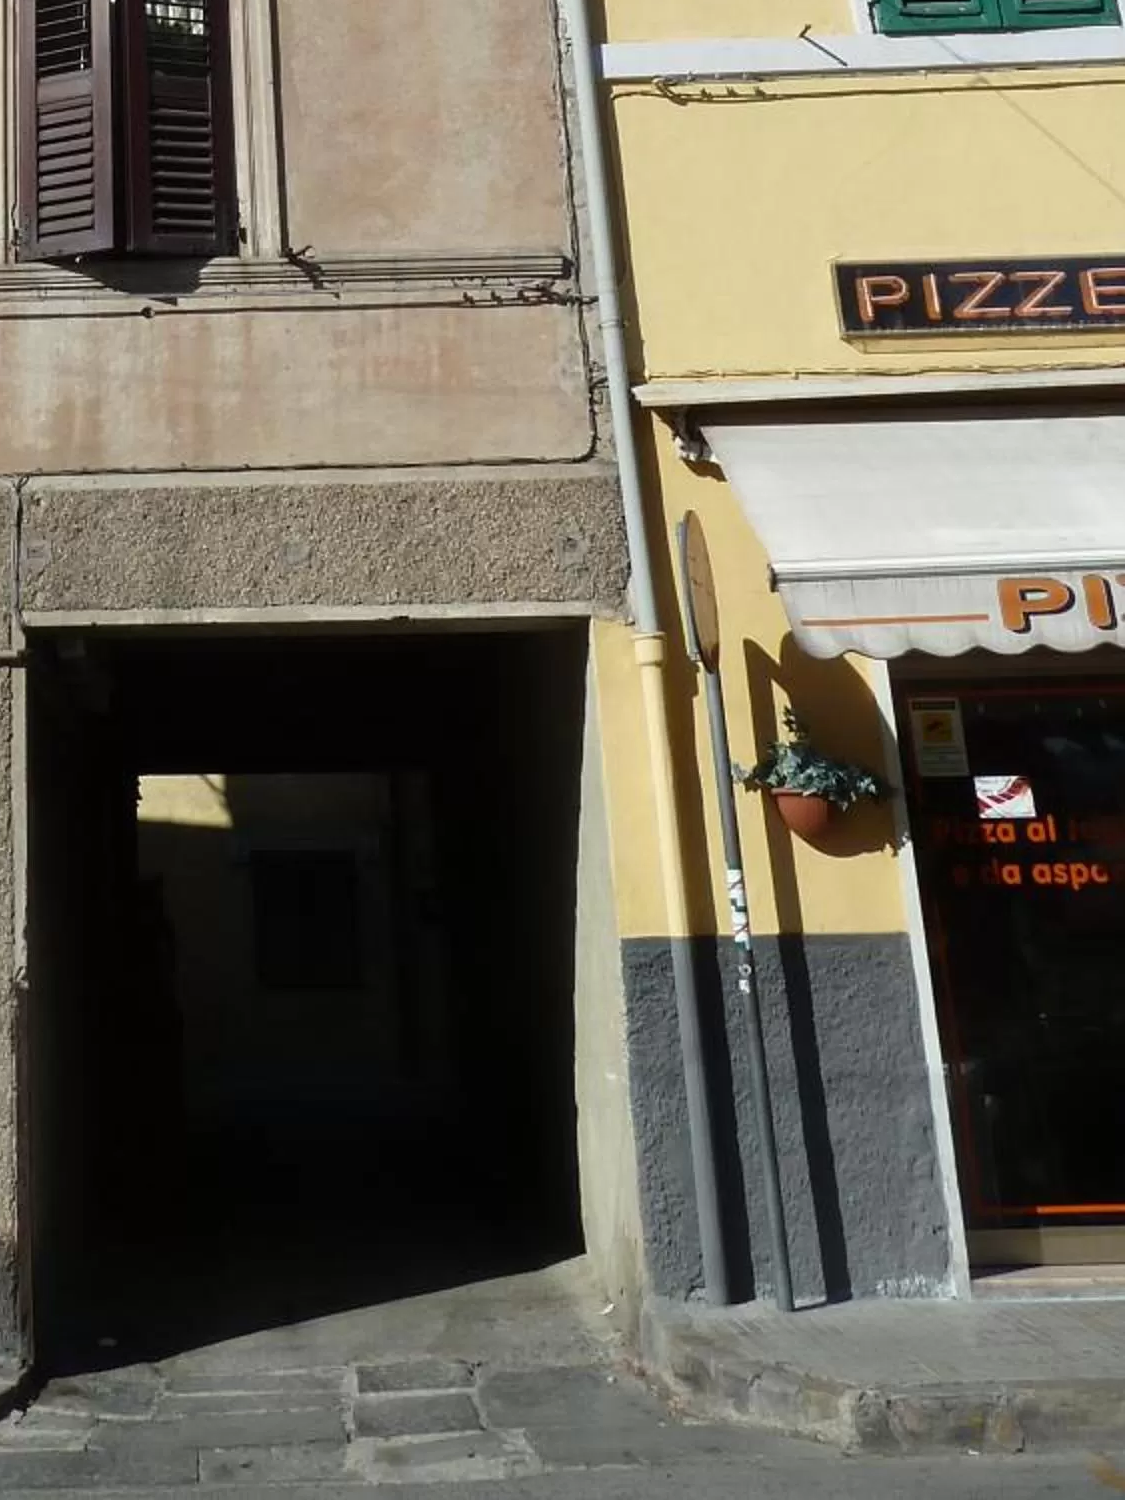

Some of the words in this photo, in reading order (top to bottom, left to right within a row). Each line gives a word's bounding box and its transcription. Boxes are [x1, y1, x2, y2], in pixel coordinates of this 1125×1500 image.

[855, 267, 1125, 323] PIZZE
[997, 573, 1125, 635] PI
[1026, 812, 1058, 844] al
